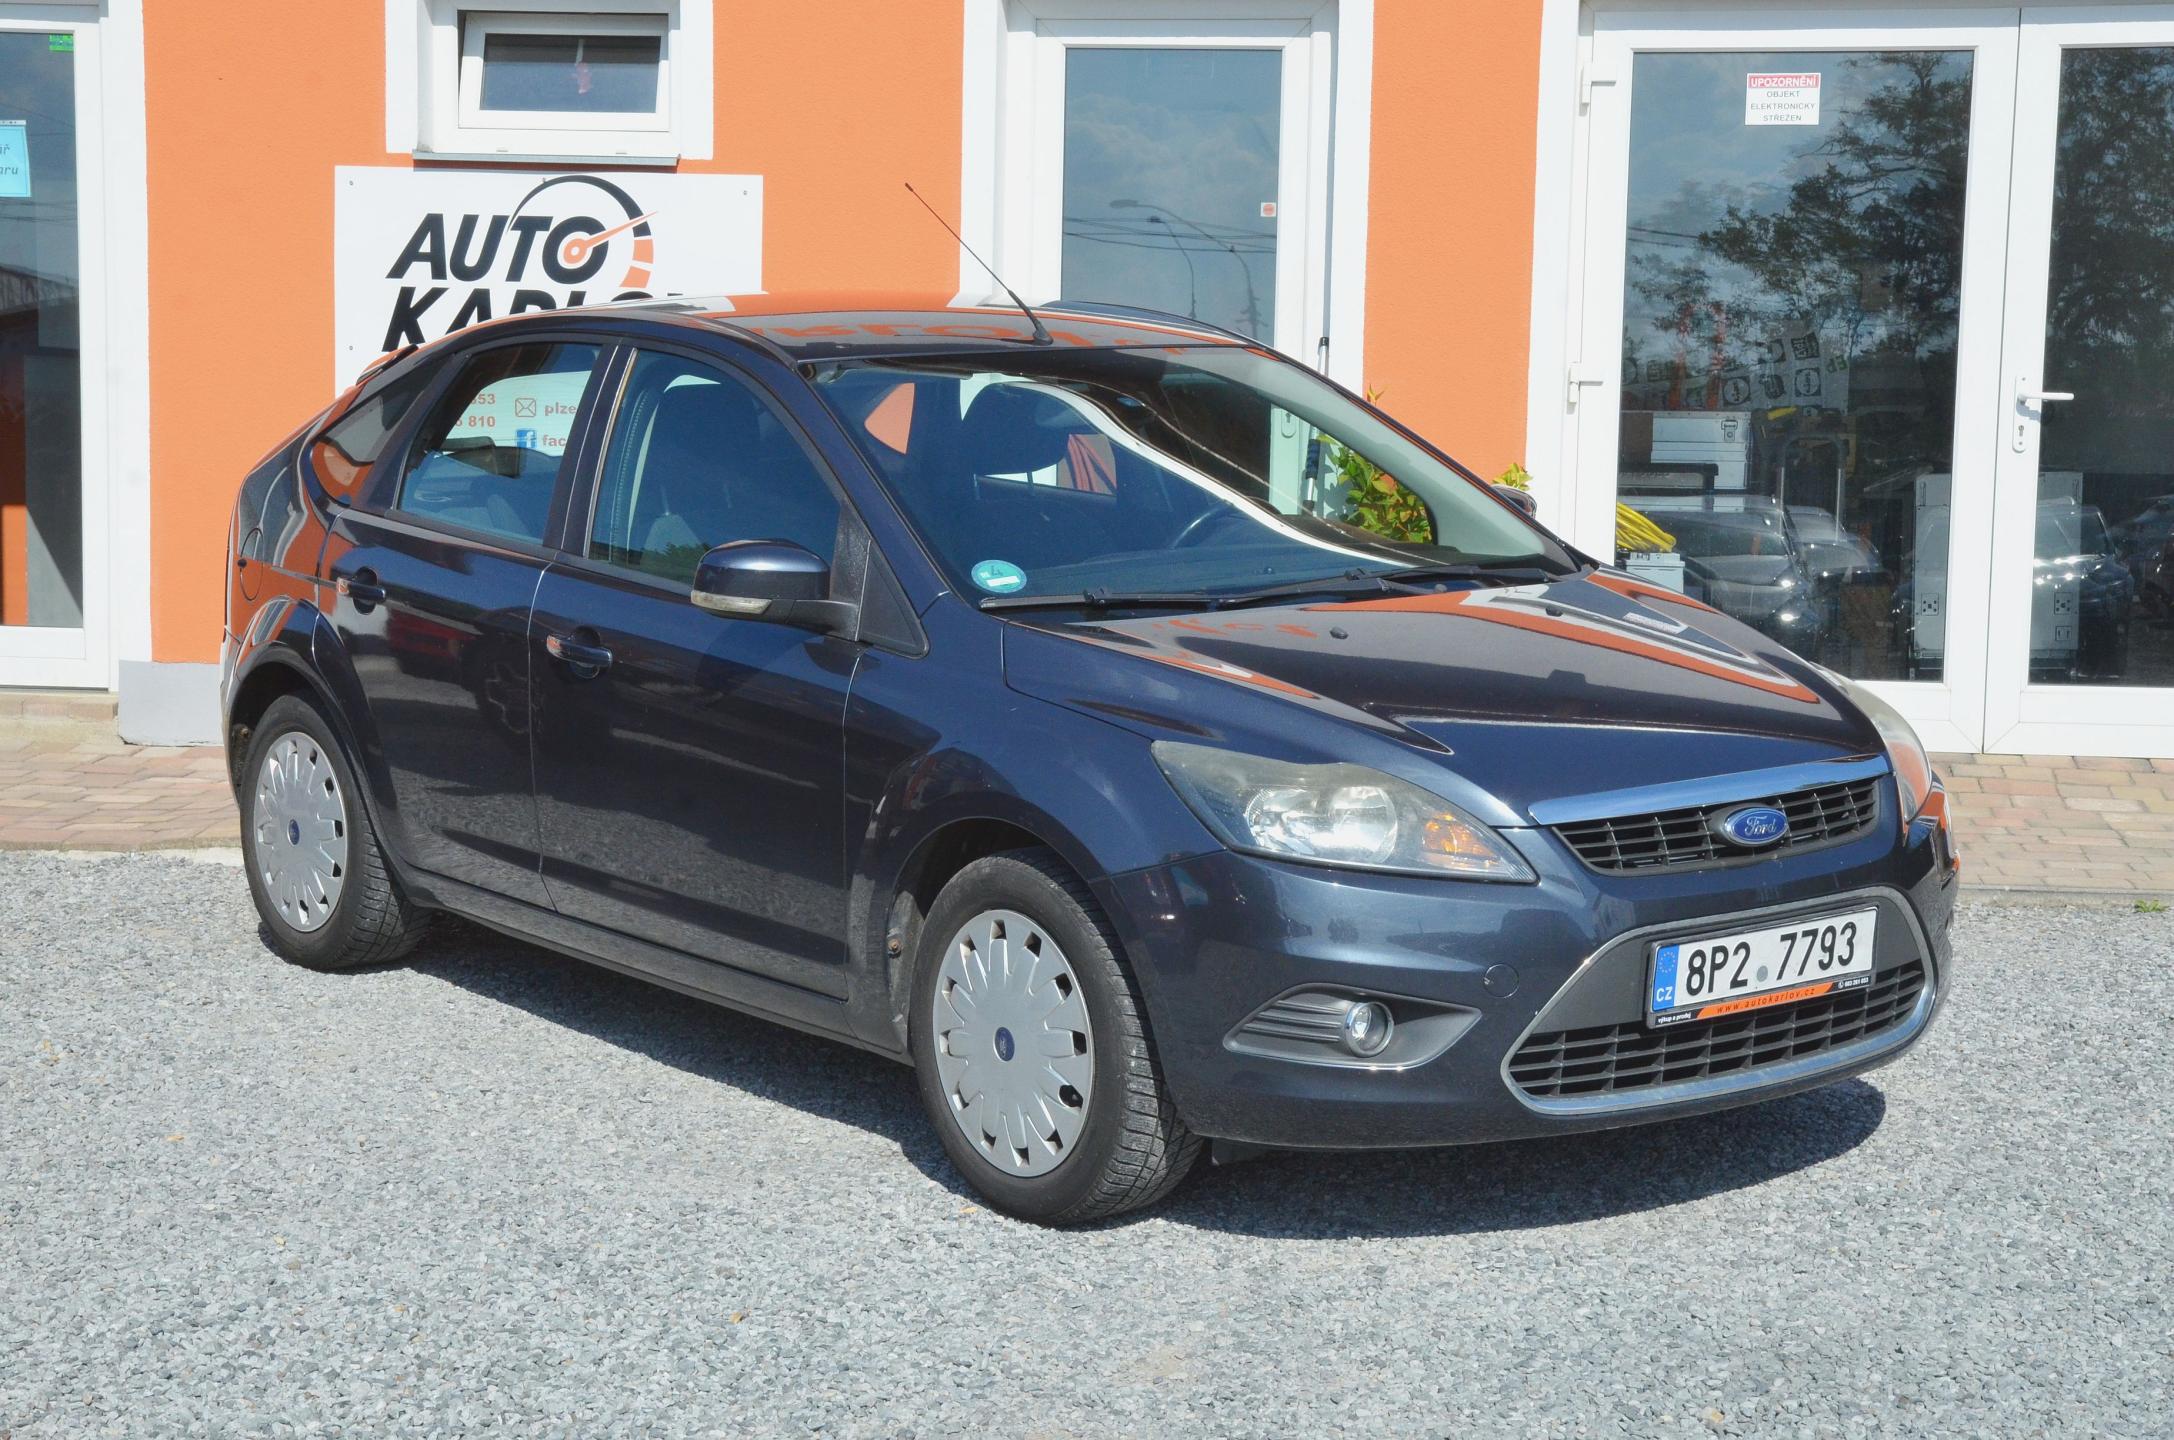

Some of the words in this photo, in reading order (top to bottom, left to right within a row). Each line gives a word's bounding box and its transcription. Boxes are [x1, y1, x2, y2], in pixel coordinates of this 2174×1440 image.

[1750, 74, 1817, 88] UPOZORNĚNÍ
[1766, 90, 1801, 98] OBJEKT
[1750, 102, 1816, 110] ELEKTRONICKY
[385, 212, 609, 285] AUTO
[544, 402, 578, 416] plze
[468, 415, 496, 427] 810
[1744, 815, 1777, 836] Ford
[1685, 941, 1751, 997] 8P2
[1776, 921, 1857, 981] 7793
[1656, 986, 1673, 1002] CZ
[1717, 988, 1816, 1014] www.autokarlov.cz
